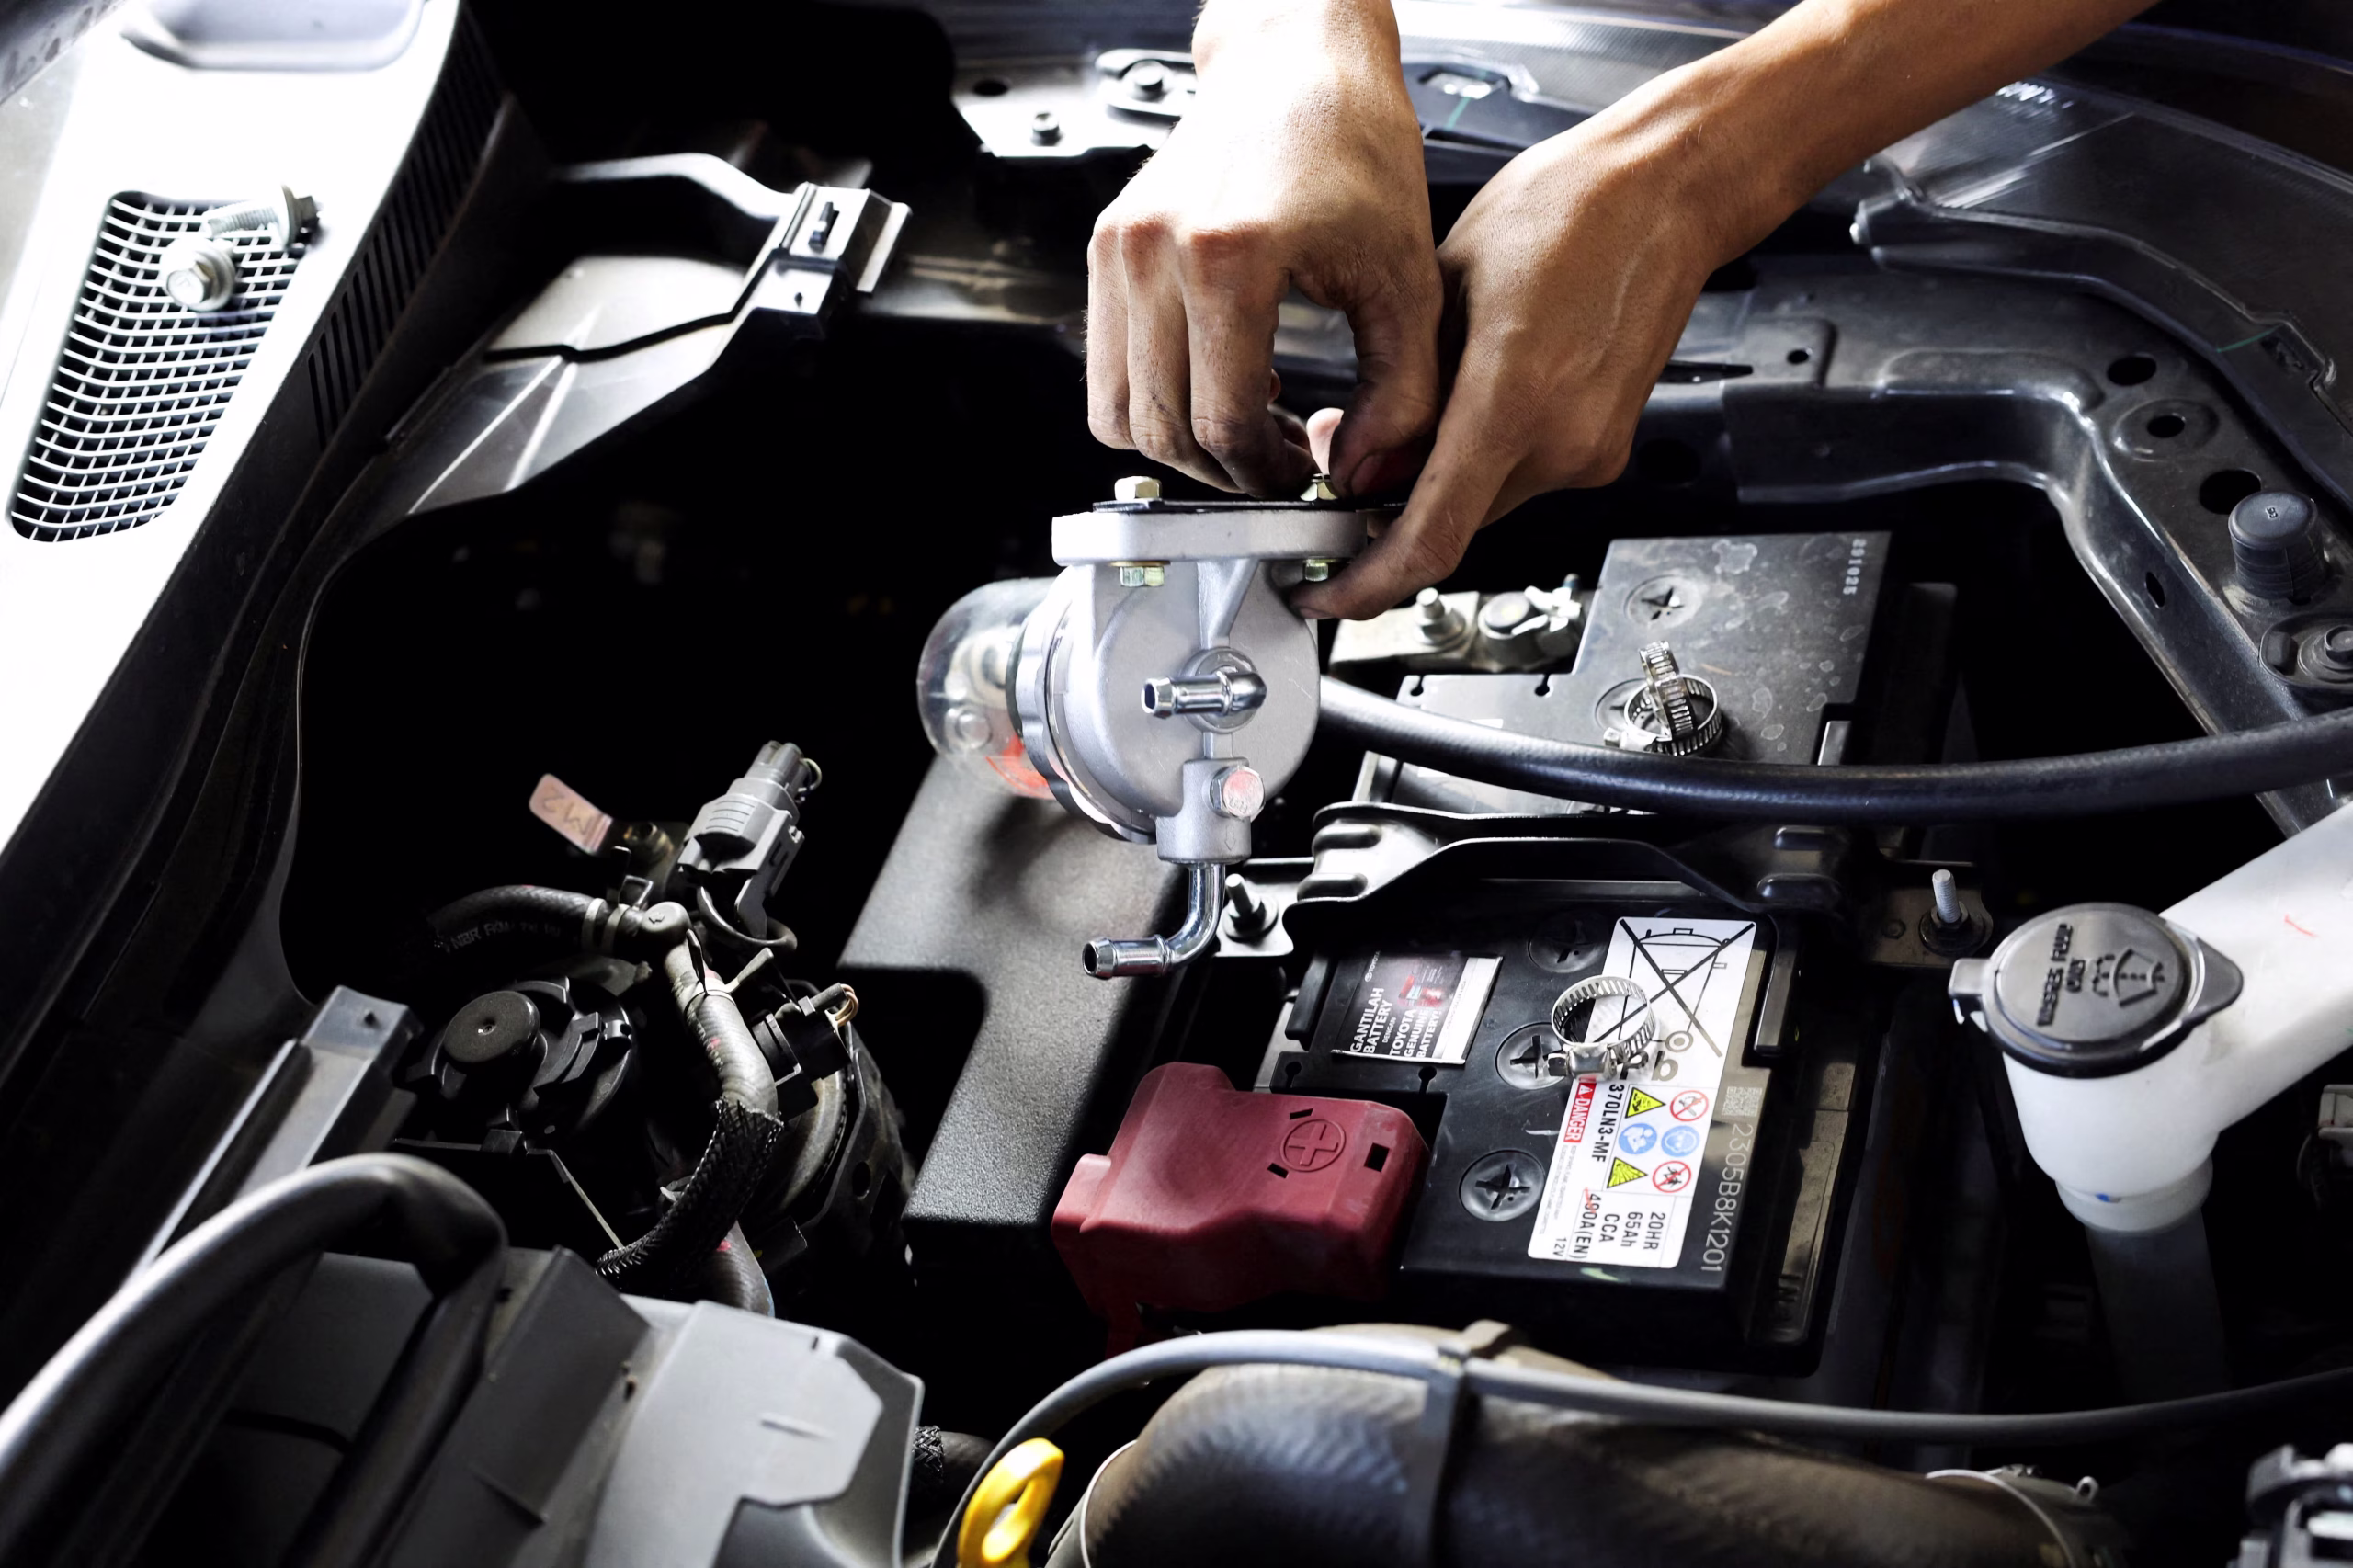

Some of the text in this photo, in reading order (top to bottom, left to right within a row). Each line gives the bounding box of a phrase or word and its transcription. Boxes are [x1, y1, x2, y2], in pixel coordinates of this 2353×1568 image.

[1350, 987, 1384, 1053] GANTILAH
[1363, 1001, 1392, 1054] BATTERY
[1382, 1017, 1396, 1043] DENGAN
[1390, 1009, 1415, 1056] TOYOTA
[1404, 1008, 1426, 1057] GENUINE
[1416, 1009, 1442, 1058] BATTERY!
[1565, 1098, 1592, 1142] DANGER
[1591, 1084, 1625, 1163] 370LN3-MF
[1700, 1123, 1754, 1272] 2305B8K1201
[1552, 1237, 1568, 1256] 12V
[1599, 1213, 1620, 1243] CCA
[1620, 1211, 1643, 1247] 65Ah
[1643, 1212, 1666, 1250] 20HR
